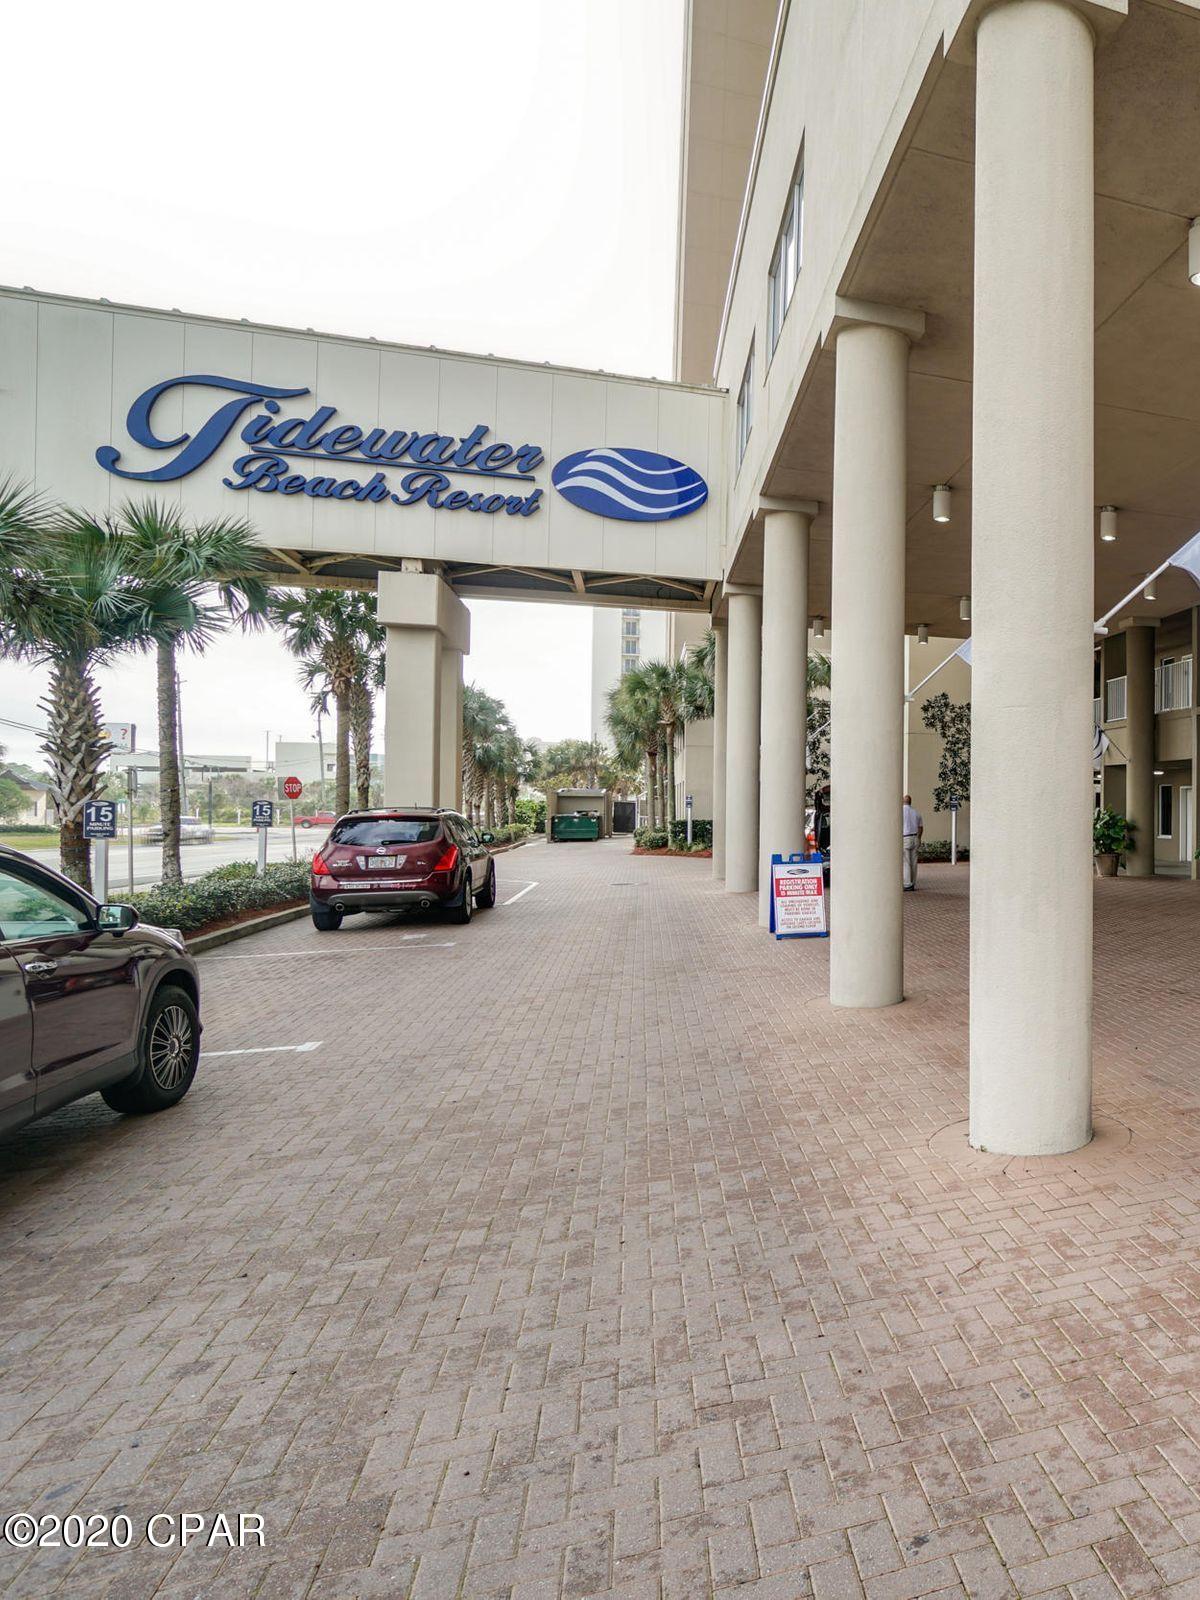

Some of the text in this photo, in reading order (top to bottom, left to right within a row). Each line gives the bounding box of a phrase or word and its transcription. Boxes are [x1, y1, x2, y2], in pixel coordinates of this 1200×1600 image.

[95, 374, 544, 482] Tidewater
[223, 453, 543, 517] Beach Resort
[284, 784, 301, 792] STOP
[86, 806, 113, 822] 15
[253, 805, 271, 815] 15
